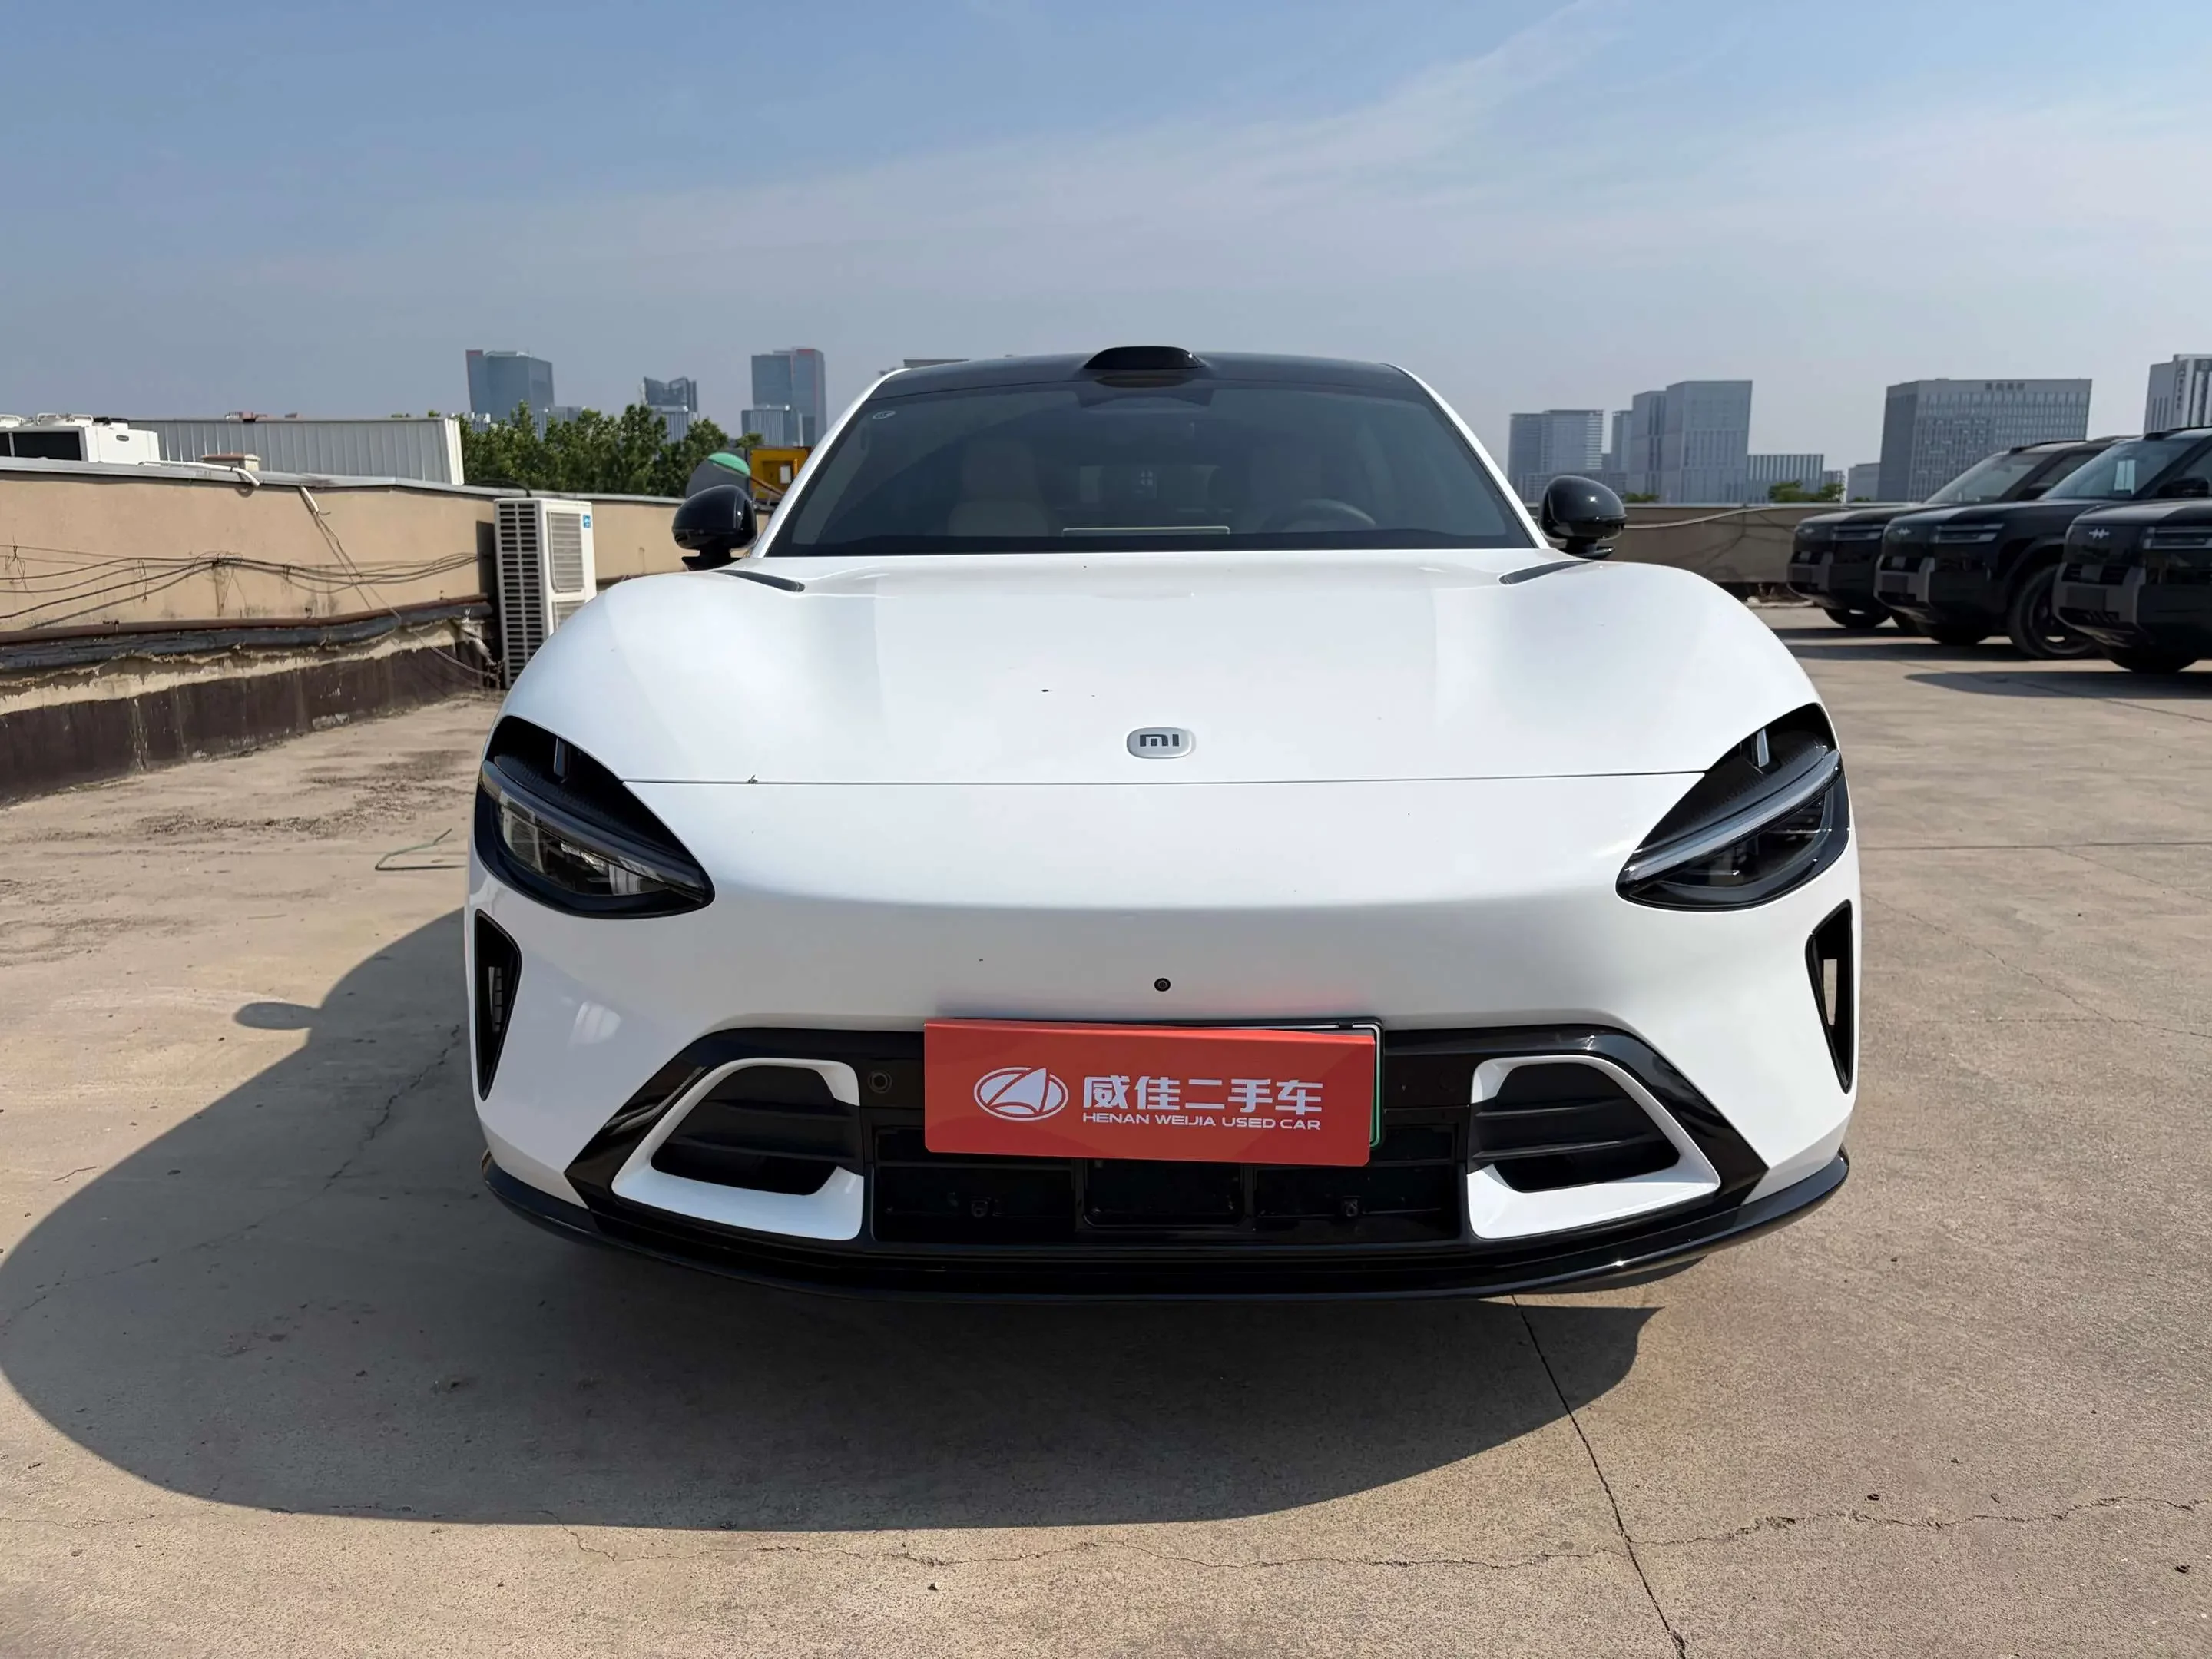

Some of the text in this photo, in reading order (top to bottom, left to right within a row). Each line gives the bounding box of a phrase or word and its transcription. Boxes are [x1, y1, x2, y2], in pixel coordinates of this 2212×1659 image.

[1083, 1075, 1323, 1116] 威佳二手车
[1082, 1112, 1321, 1131] HENAN WEIJIA USED CAR
